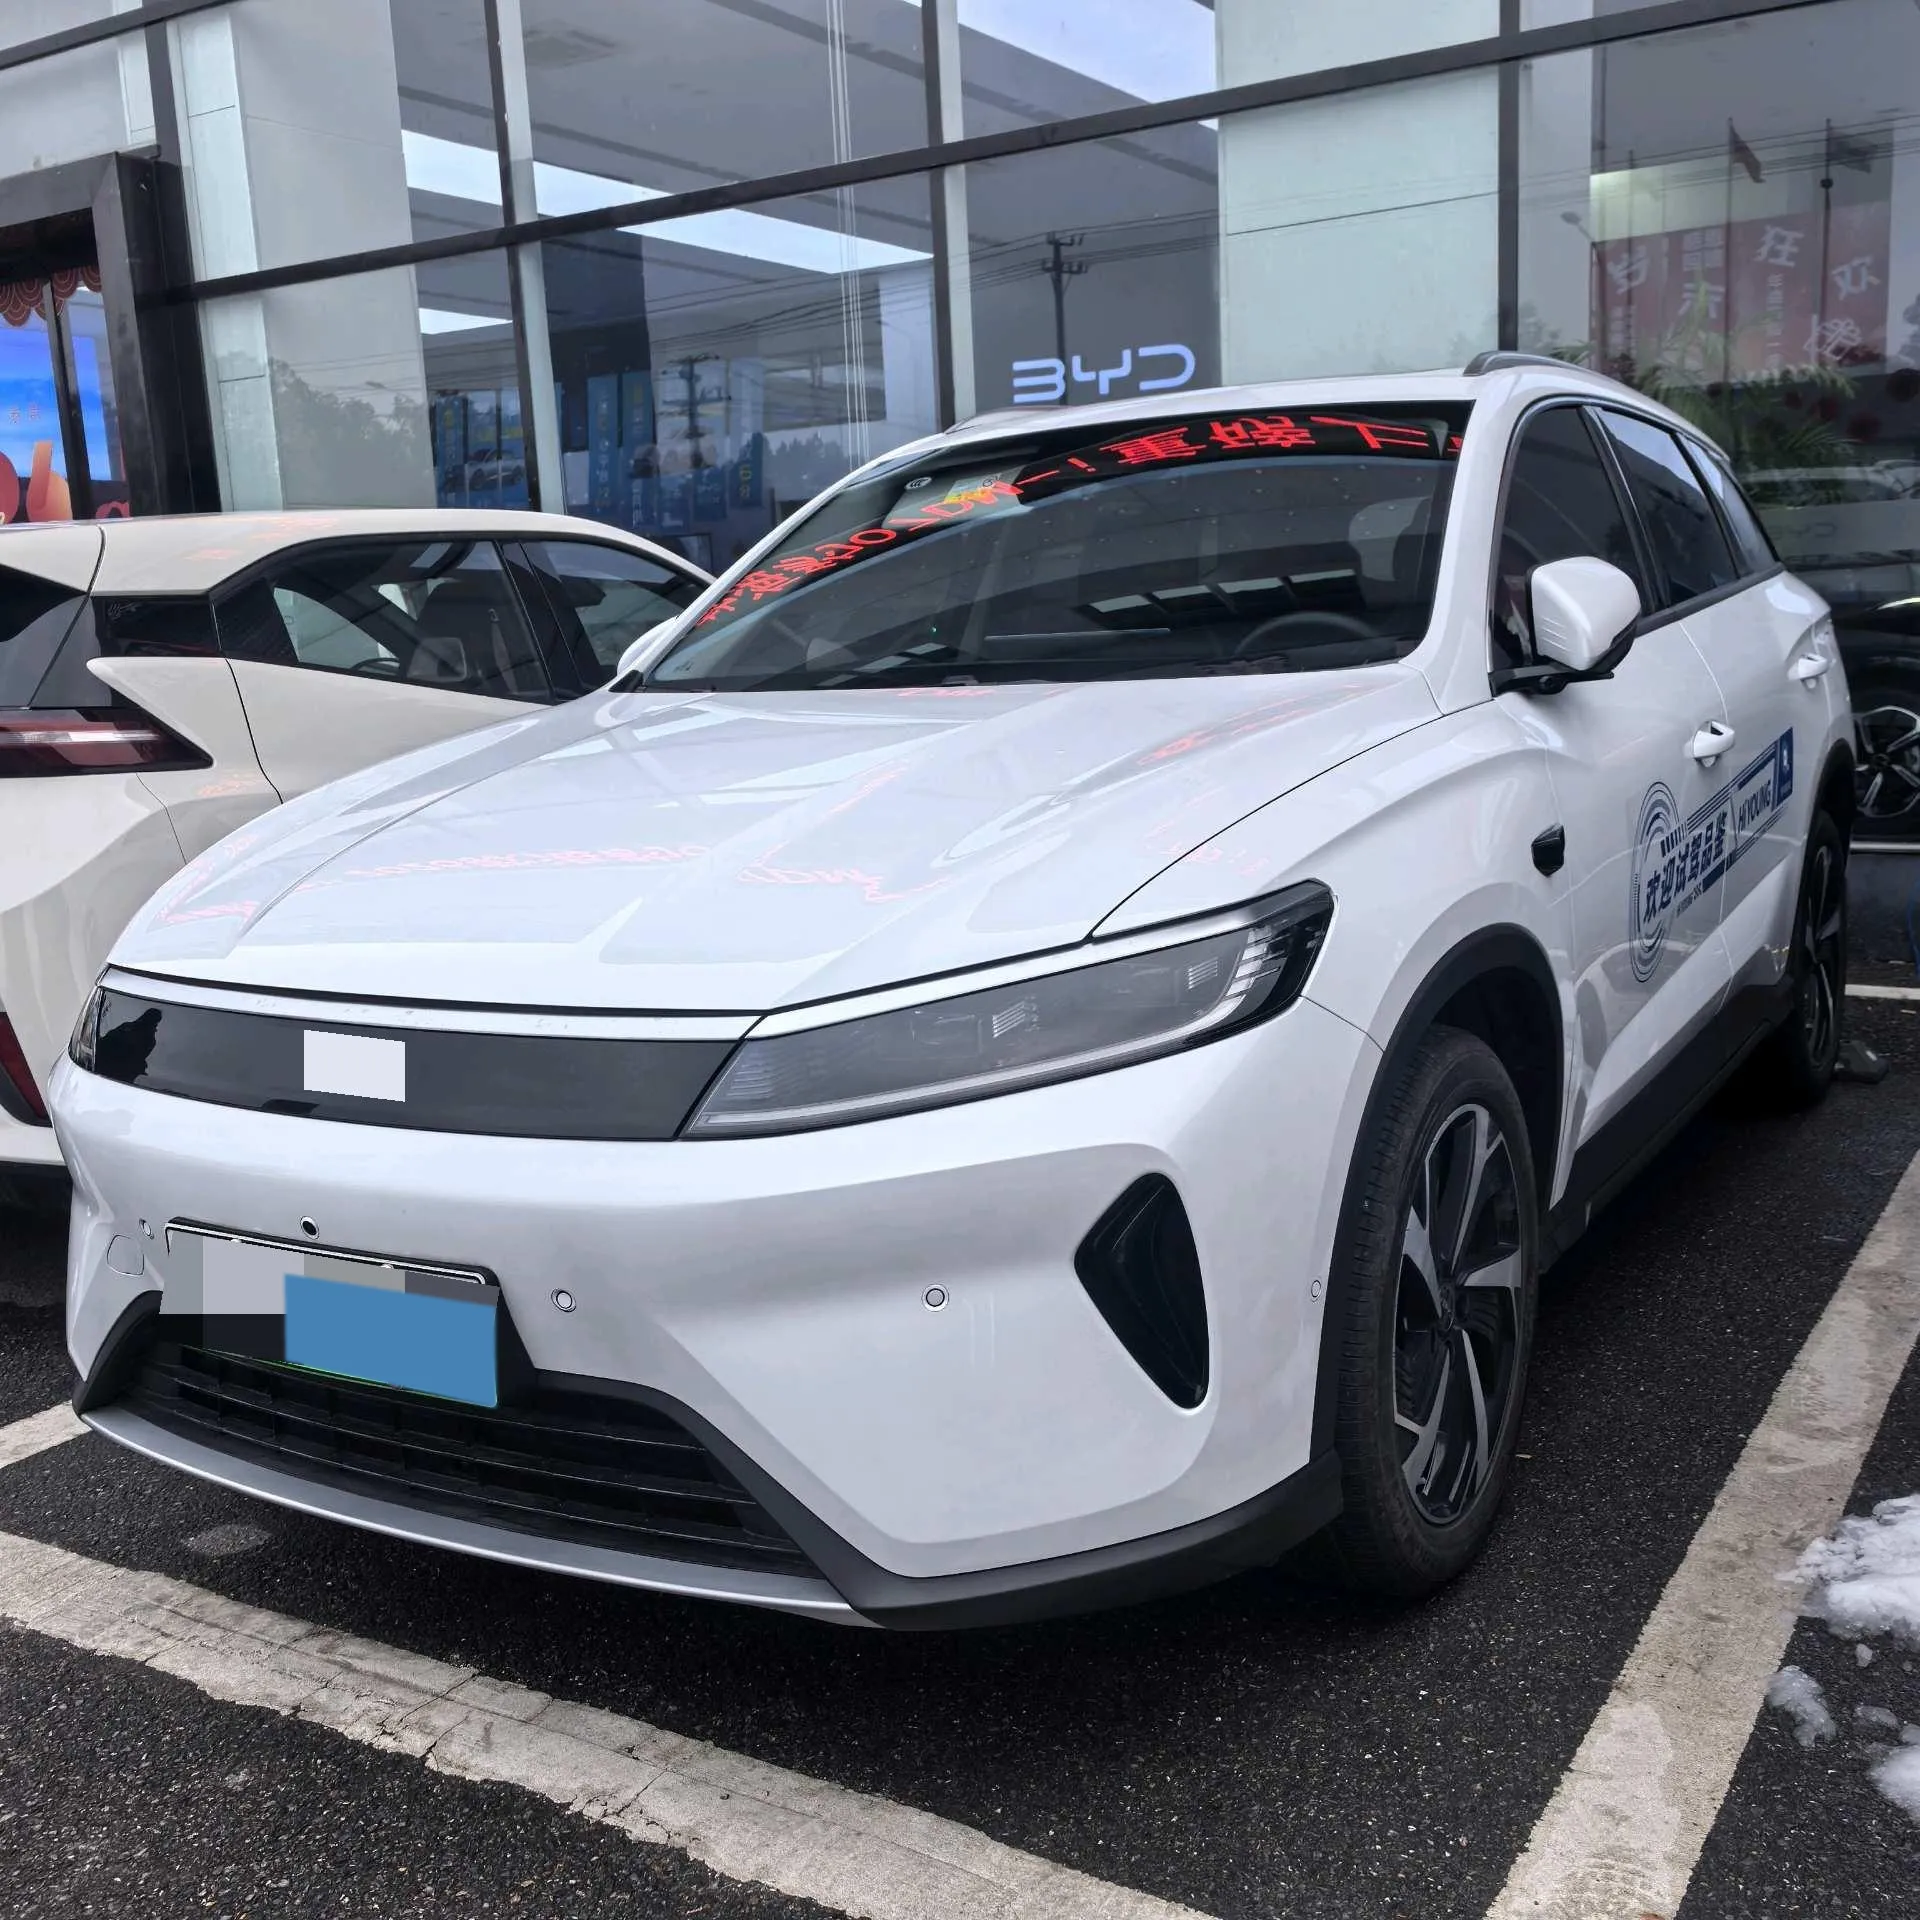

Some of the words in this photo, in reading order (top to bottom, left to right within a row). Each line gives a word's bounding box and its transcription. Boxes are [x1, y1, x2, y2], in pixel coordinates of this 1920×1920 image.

[1012, 344, 1196, 404] BYD
[1644, 811, 1728, 924] 欢迎试驾品鉴
